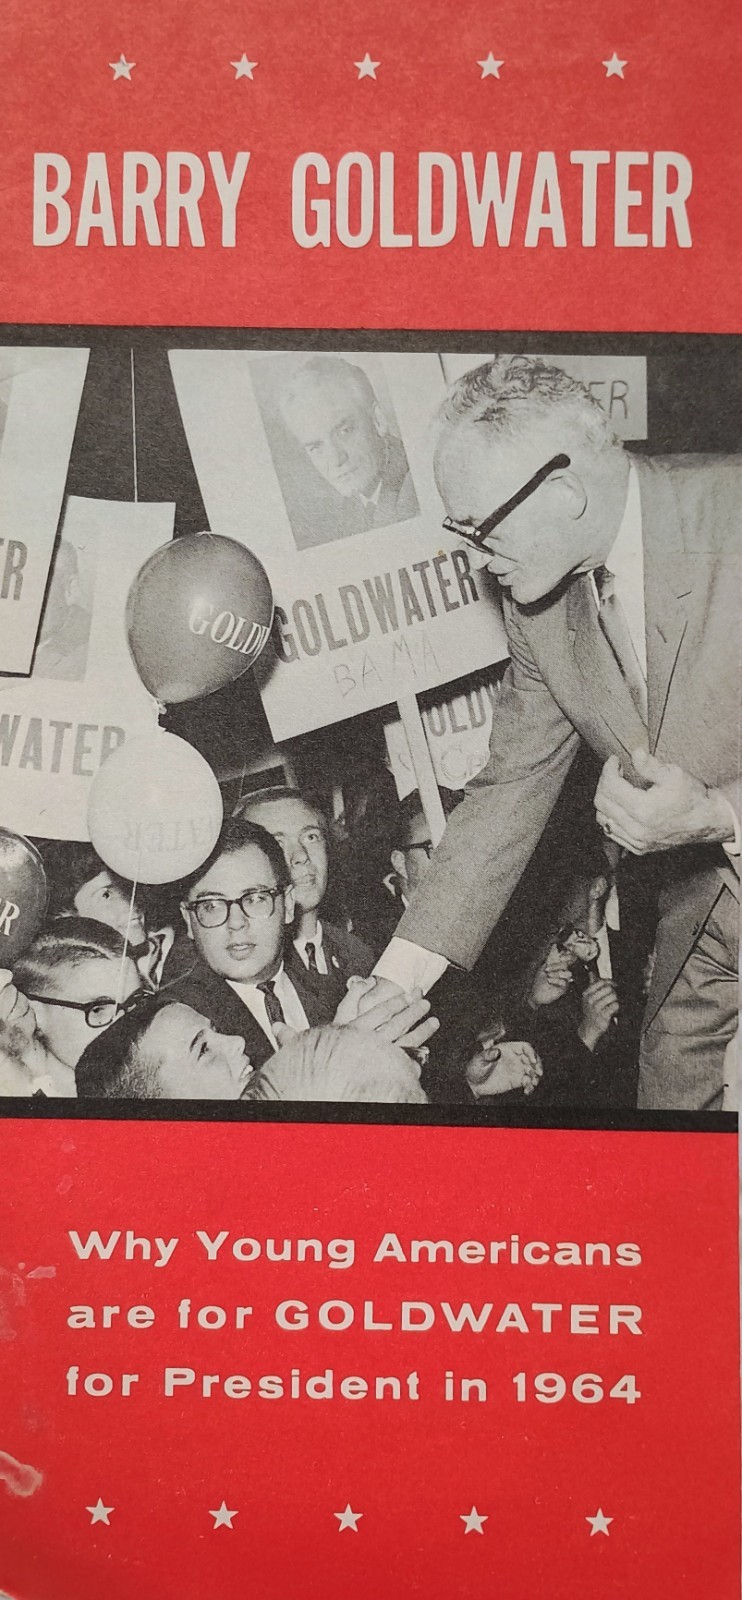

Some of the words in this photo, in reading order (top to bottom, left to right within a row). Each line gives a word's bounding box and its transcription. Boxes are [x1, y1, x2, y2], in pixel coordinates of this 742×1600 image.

[33, 151, 250, 247] BARRY
[292, 151, 692, 248] GOLDWATER
[273, 549, 480, 664] GOLDWATER
[333, 632, 441, 697] BAMA
[69, 1231, 178, 1267] Why
[197, 1231, 354, 1268] Young
[374, 1234, 641, 1266] Americans
[68, 1306, 154, 1328] are
[179, 1299, 252, 1329] for
[276, 1300, 642, 1334] GOLDWATER
[67, 1367, 138, 1396] for
[165, 1368, 418, 1399] President
[446, 1372, 486, 1401] in
[513, 1373, 640, 1403] 1964
